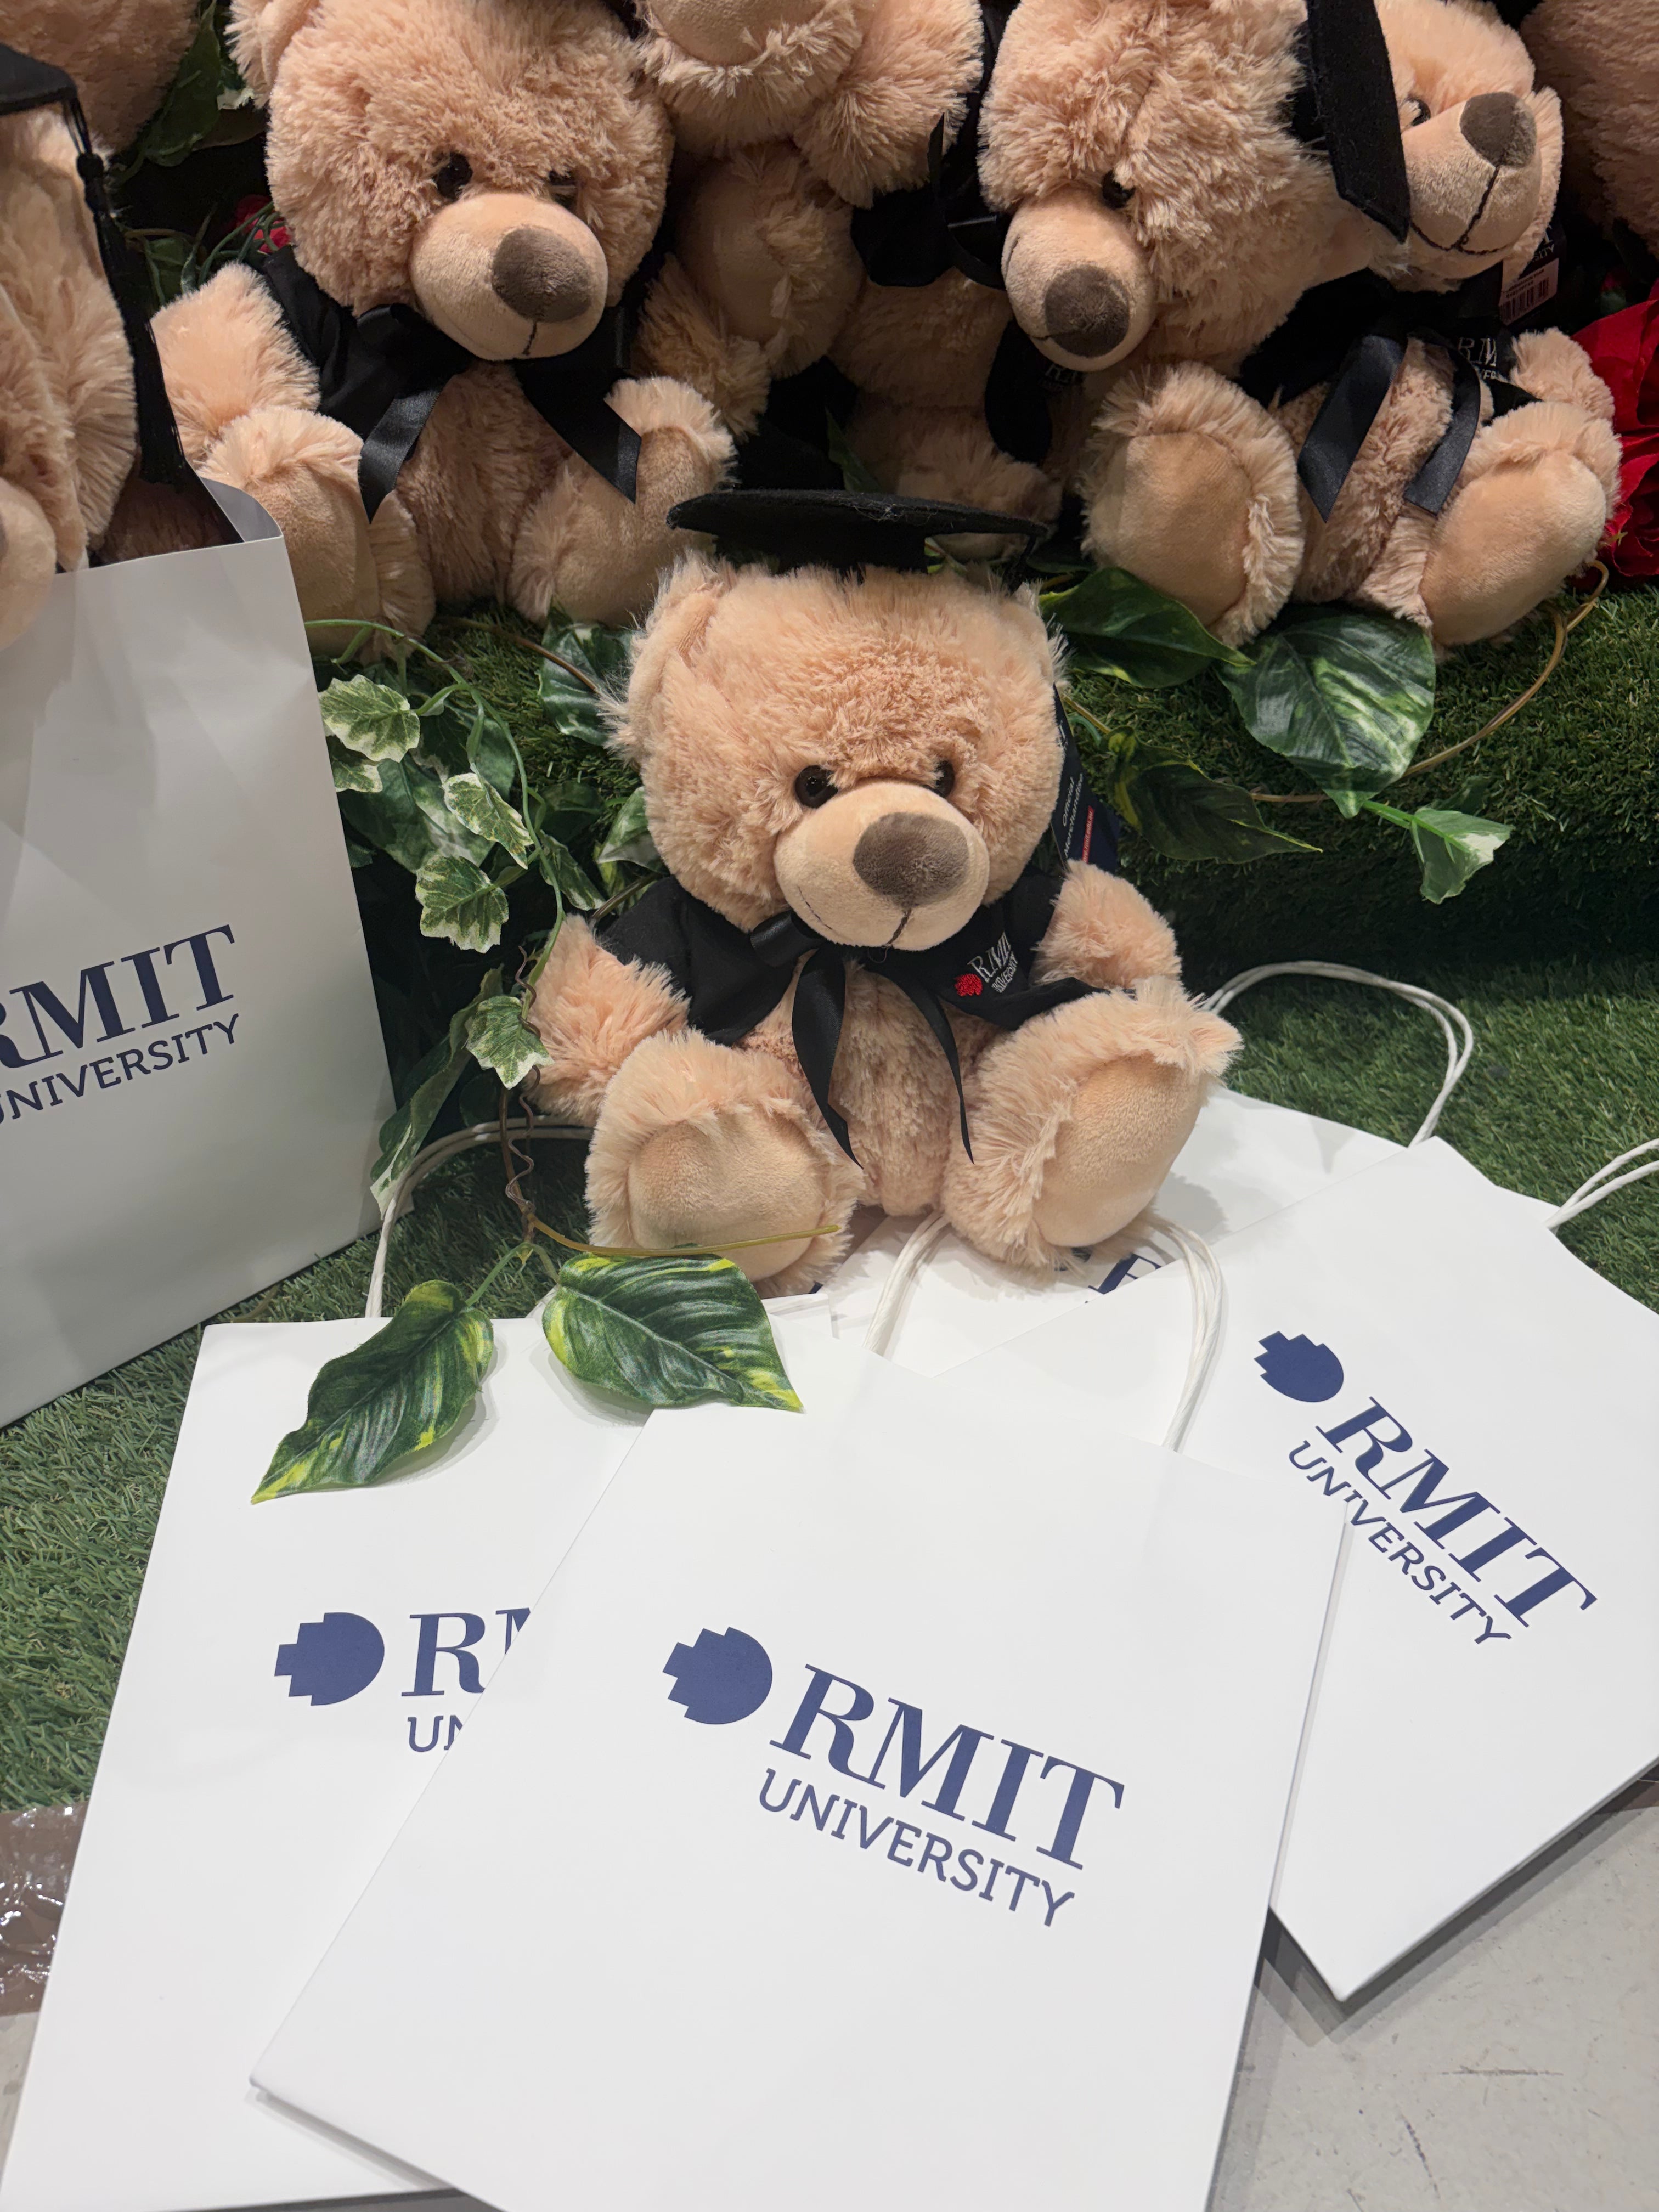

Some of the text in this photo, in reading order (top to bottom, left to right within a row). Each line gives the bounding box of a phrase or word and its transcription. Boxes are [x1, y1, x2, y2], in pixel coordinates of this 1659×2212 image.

[1063, 776, 1074, 827] Official
[1064, 773, 1083, 859] Merchandise
[1289, 1441, 1511, 1644] UNIVERSITY
[1316, 1397, 1597, 1627] RMIT
[760, 1768, 1075, 1927] UNIVERSITY
[770, 1664, 1124, 1870] RMIT
